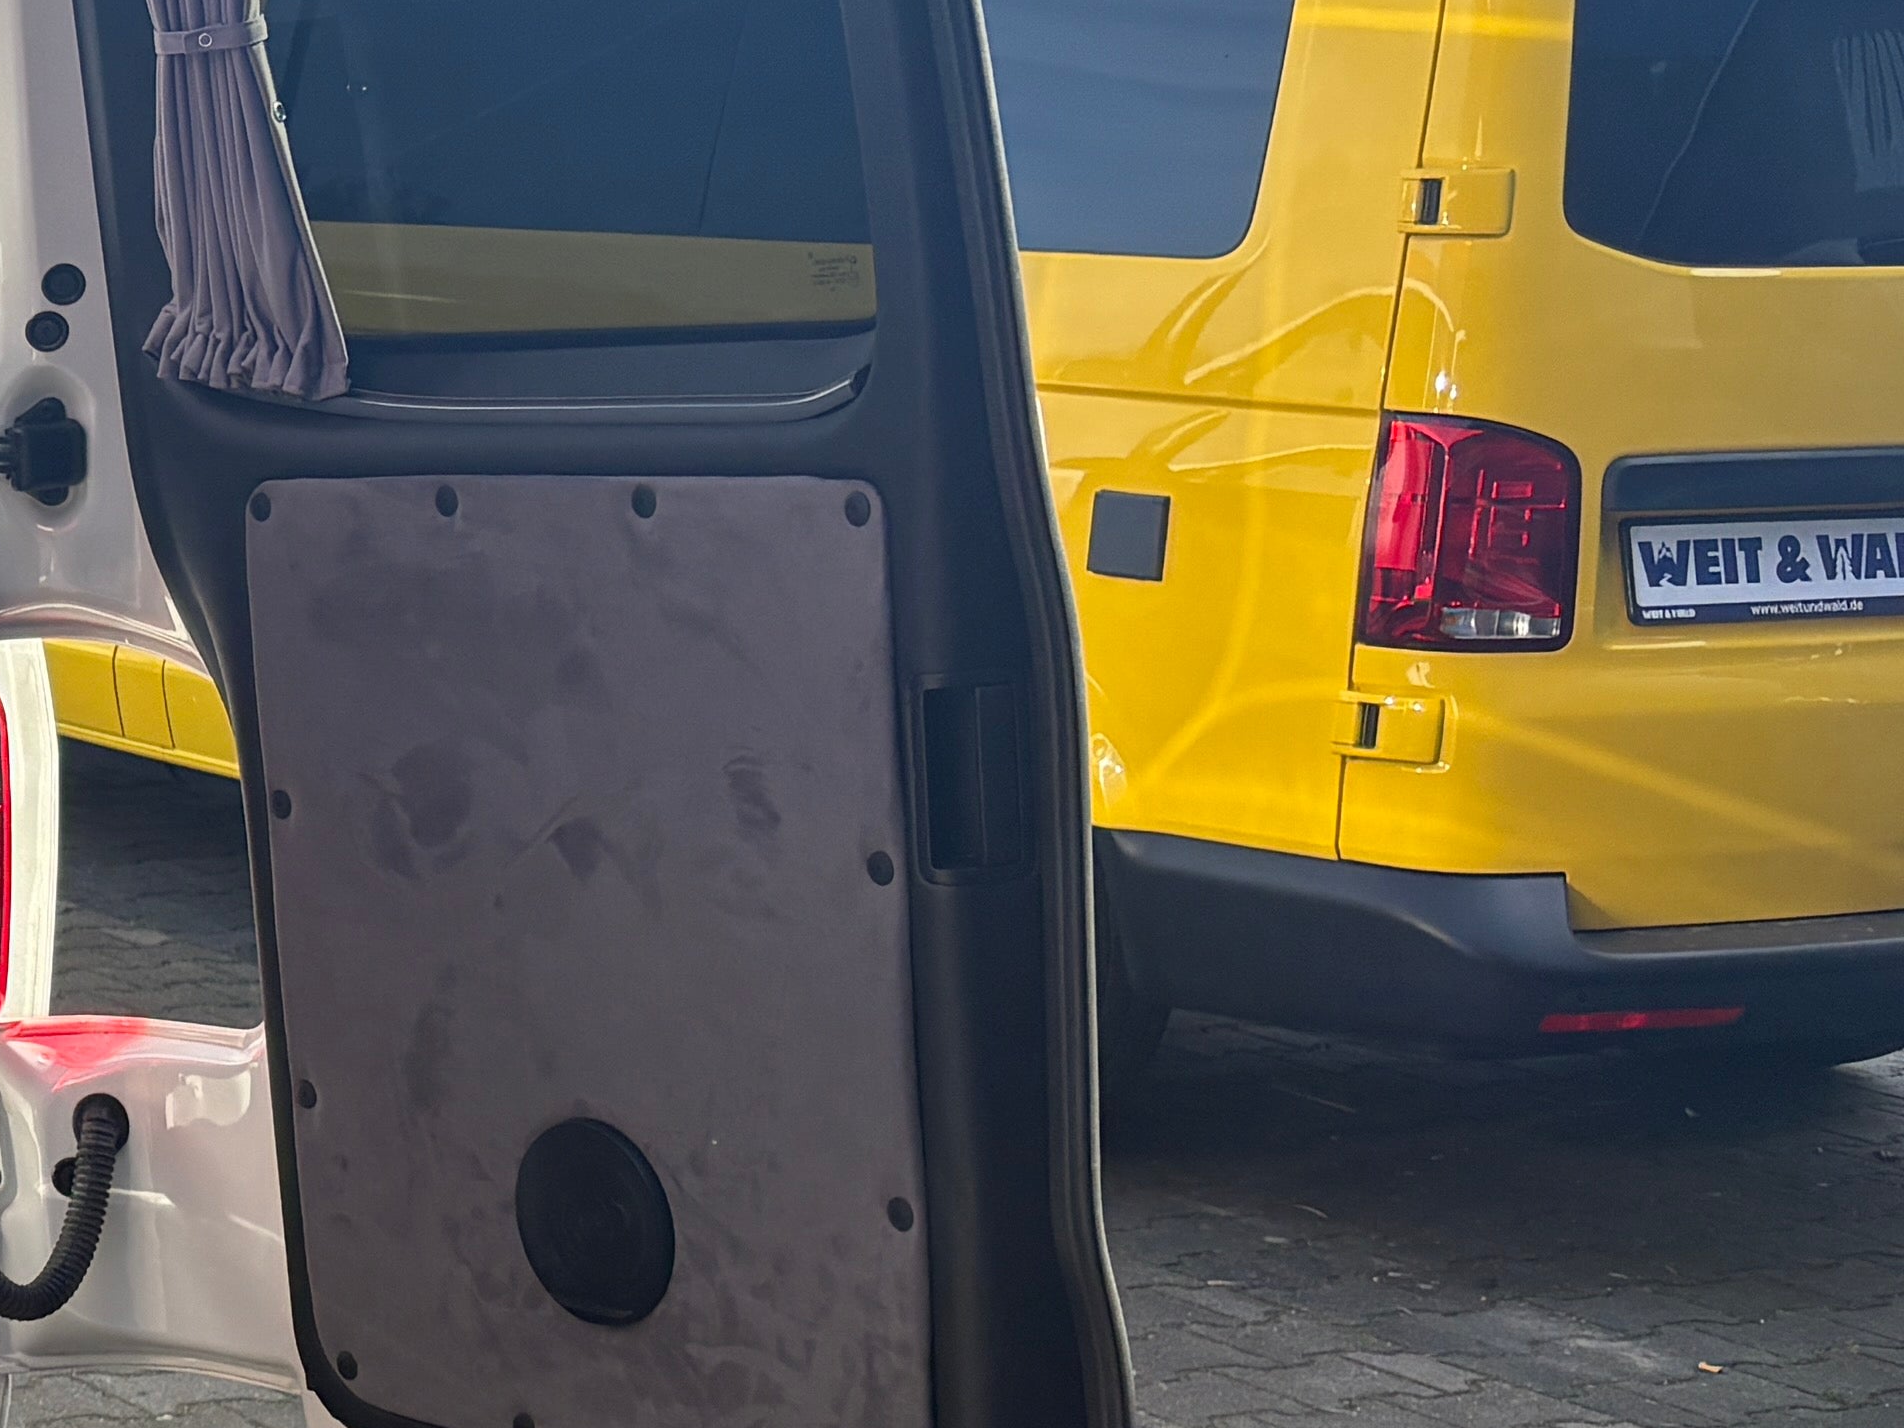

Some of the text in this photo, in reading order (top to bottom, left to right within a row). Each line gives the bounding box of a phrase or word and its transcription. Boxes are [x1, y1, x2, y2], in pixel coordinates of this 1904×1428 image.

[1638, 537, 1763, 587] WEIT
[1776, 535, 1813, 584] &
[1750, 599, 1864, 615] www.weitundwald.de
